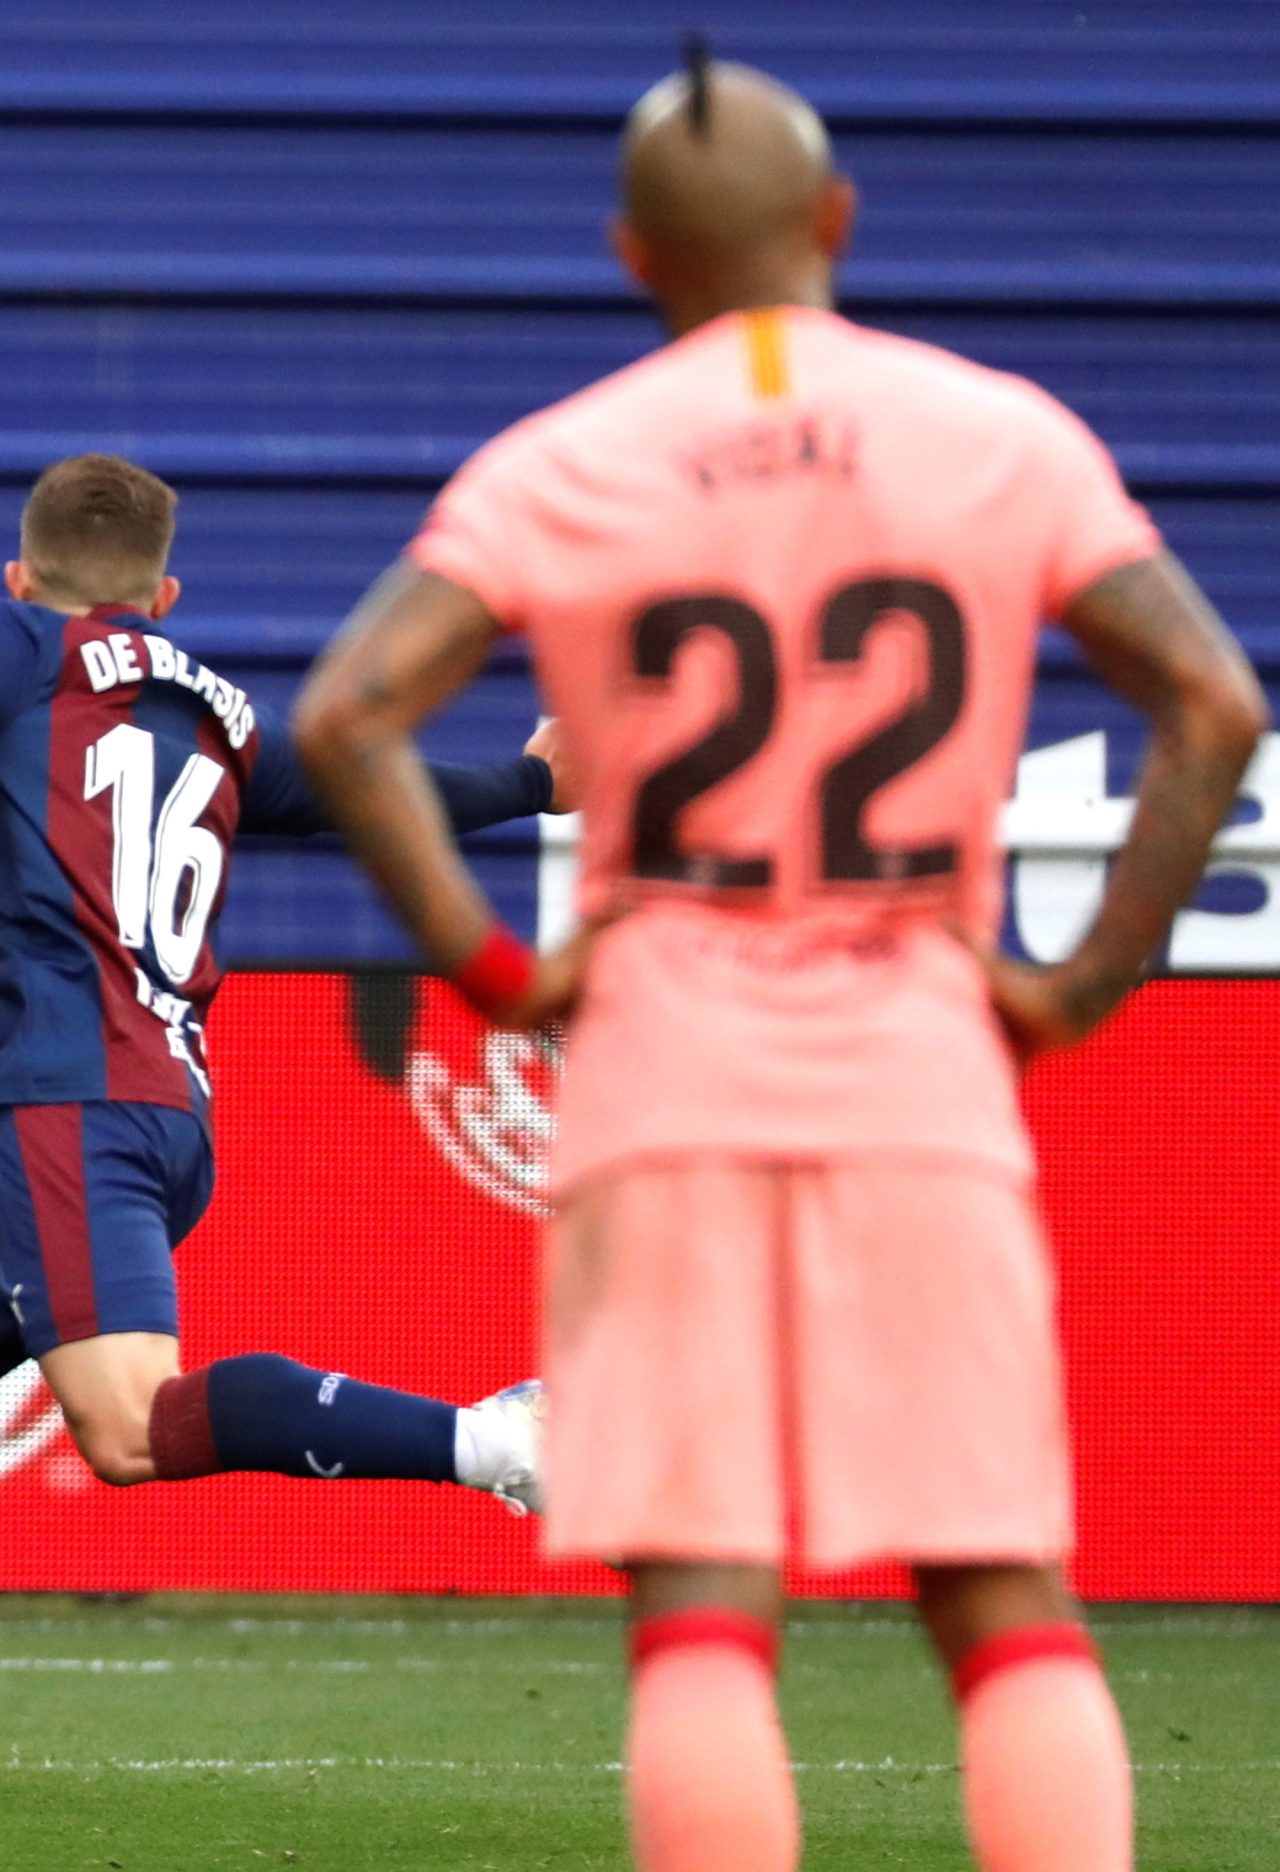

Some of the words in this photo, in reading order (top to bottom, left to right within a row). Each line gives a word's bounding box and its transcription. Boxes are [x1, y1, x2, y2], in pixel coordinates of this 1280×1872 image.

[80, 633, 143, 693] DE
[142, 634, 257, 750] BLASIS
[632, 574, 970, 890] 22
[84, 723, 225, 984] 16
